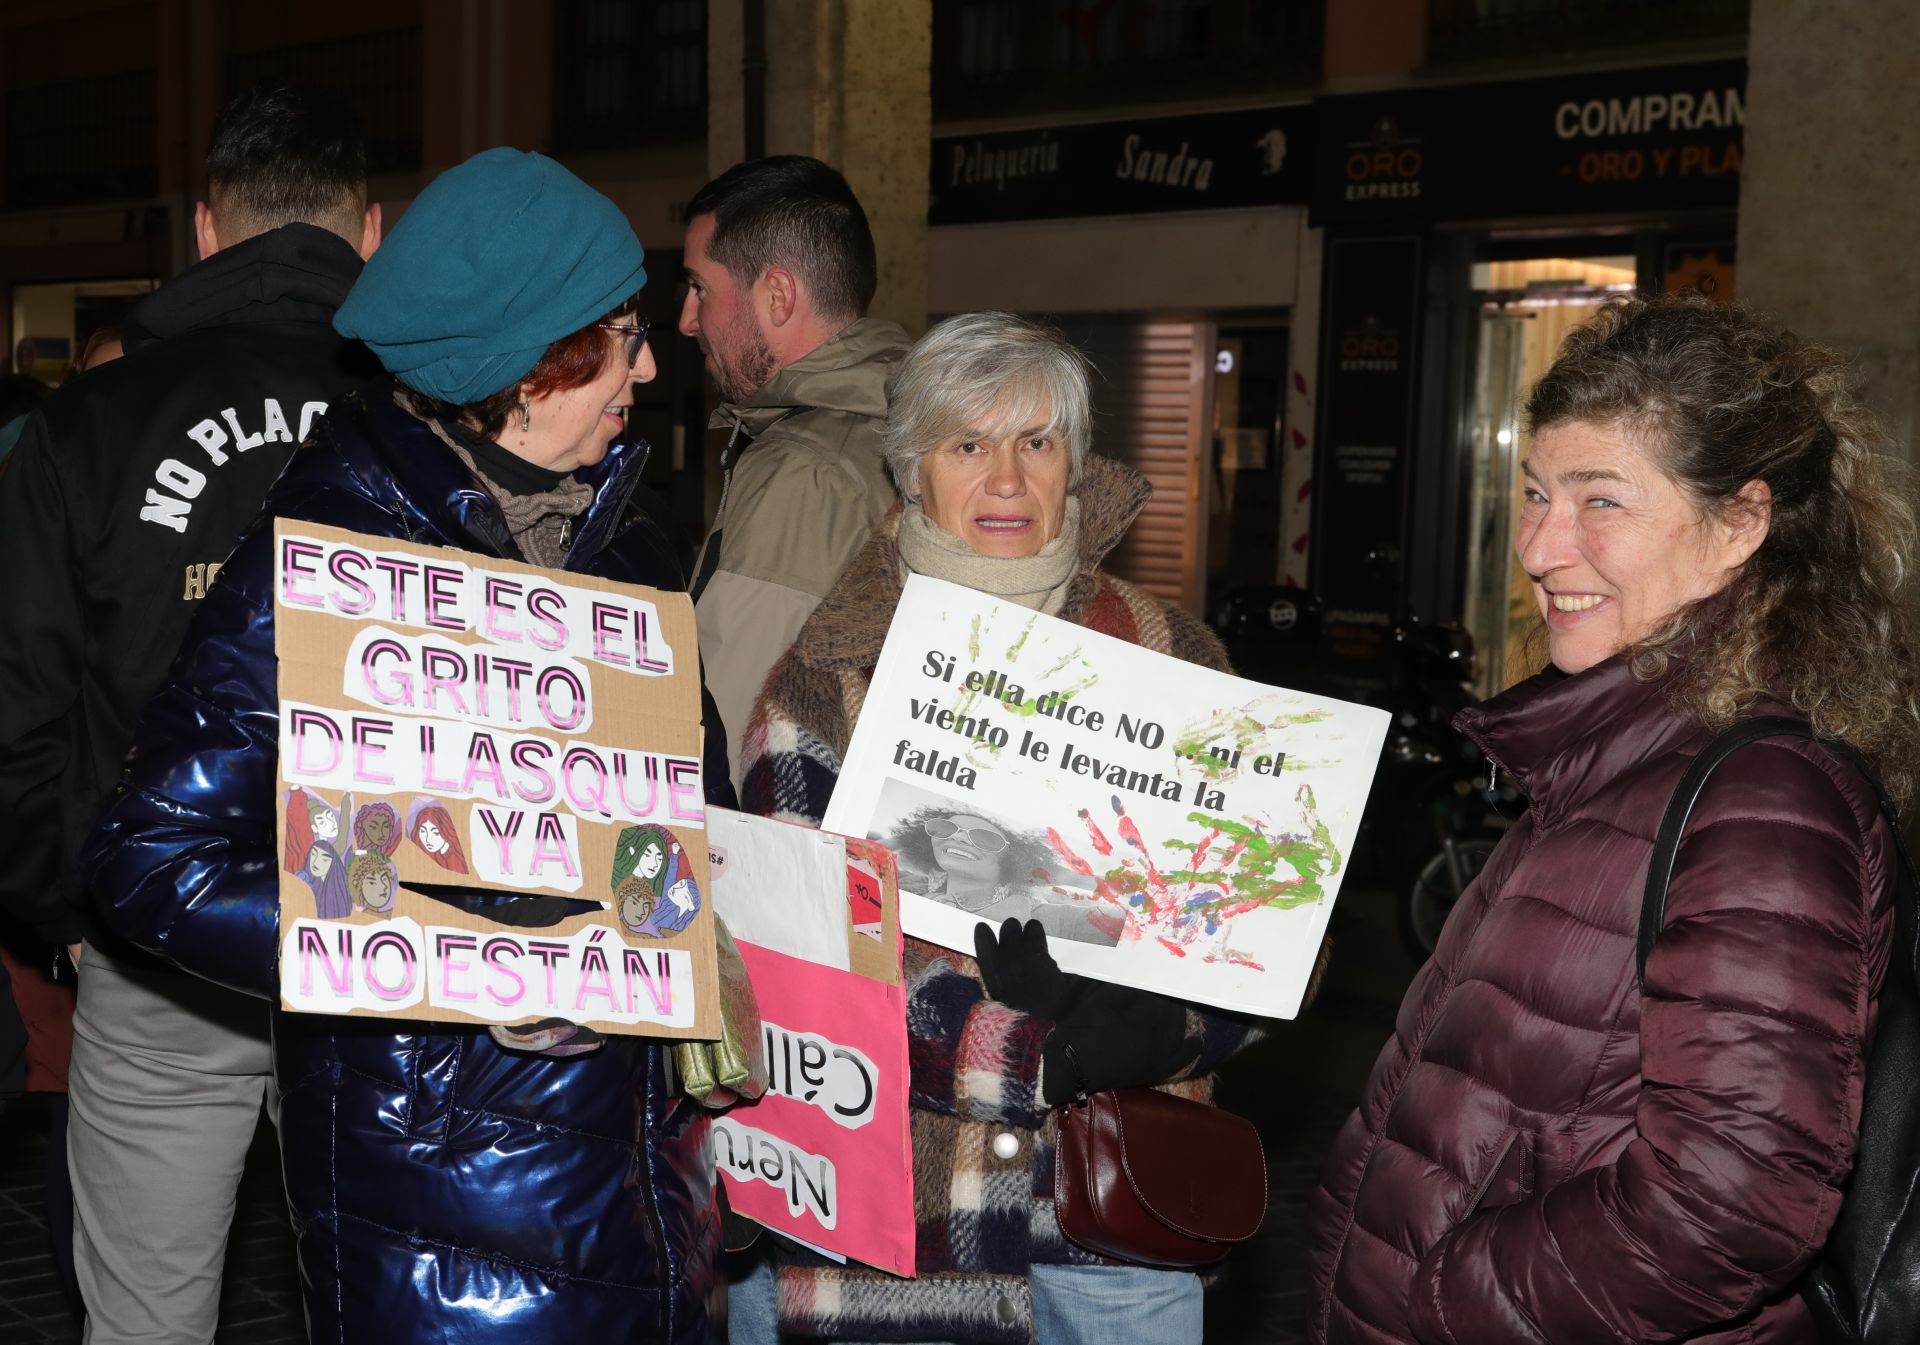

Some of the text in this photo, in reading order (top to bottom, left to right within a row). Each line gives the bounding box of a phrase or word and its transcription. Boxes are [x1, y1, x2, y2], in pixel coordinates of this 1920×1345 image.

[1116, 133, 1214, 192] Sandra
[1345, 148, 1423, 181] ORO
[1345, 181, 1422, 201] EXPRESS
[1578, 151, 1645, 184] ORO
[1653, 146, 1673, 178] Y
[1341, 359, 1399, 371] EXPRESS
[1343, 337, 1400, 357] ORO
[140, 459, 206, 533] NO
[282, 538, 670, 673] ESTE ES EL
[361, 638, 586, 730] GRITO
[922, 650, 957, 683] Si
[965, 670, 1025, 707] ella
[1036, 690, 1104, 731] dice
[1115, 713, 1164, 750] NO
[1253, 752, 1286, 778] el
[290, 709, 395, 785] DE
[893, 740, 977, 790] falda
[910, 698, 1226, 811] viento le levanta la
[477, 808, 579, 878] YA
[298, 926, 673, 1017] NO ESTÁN
